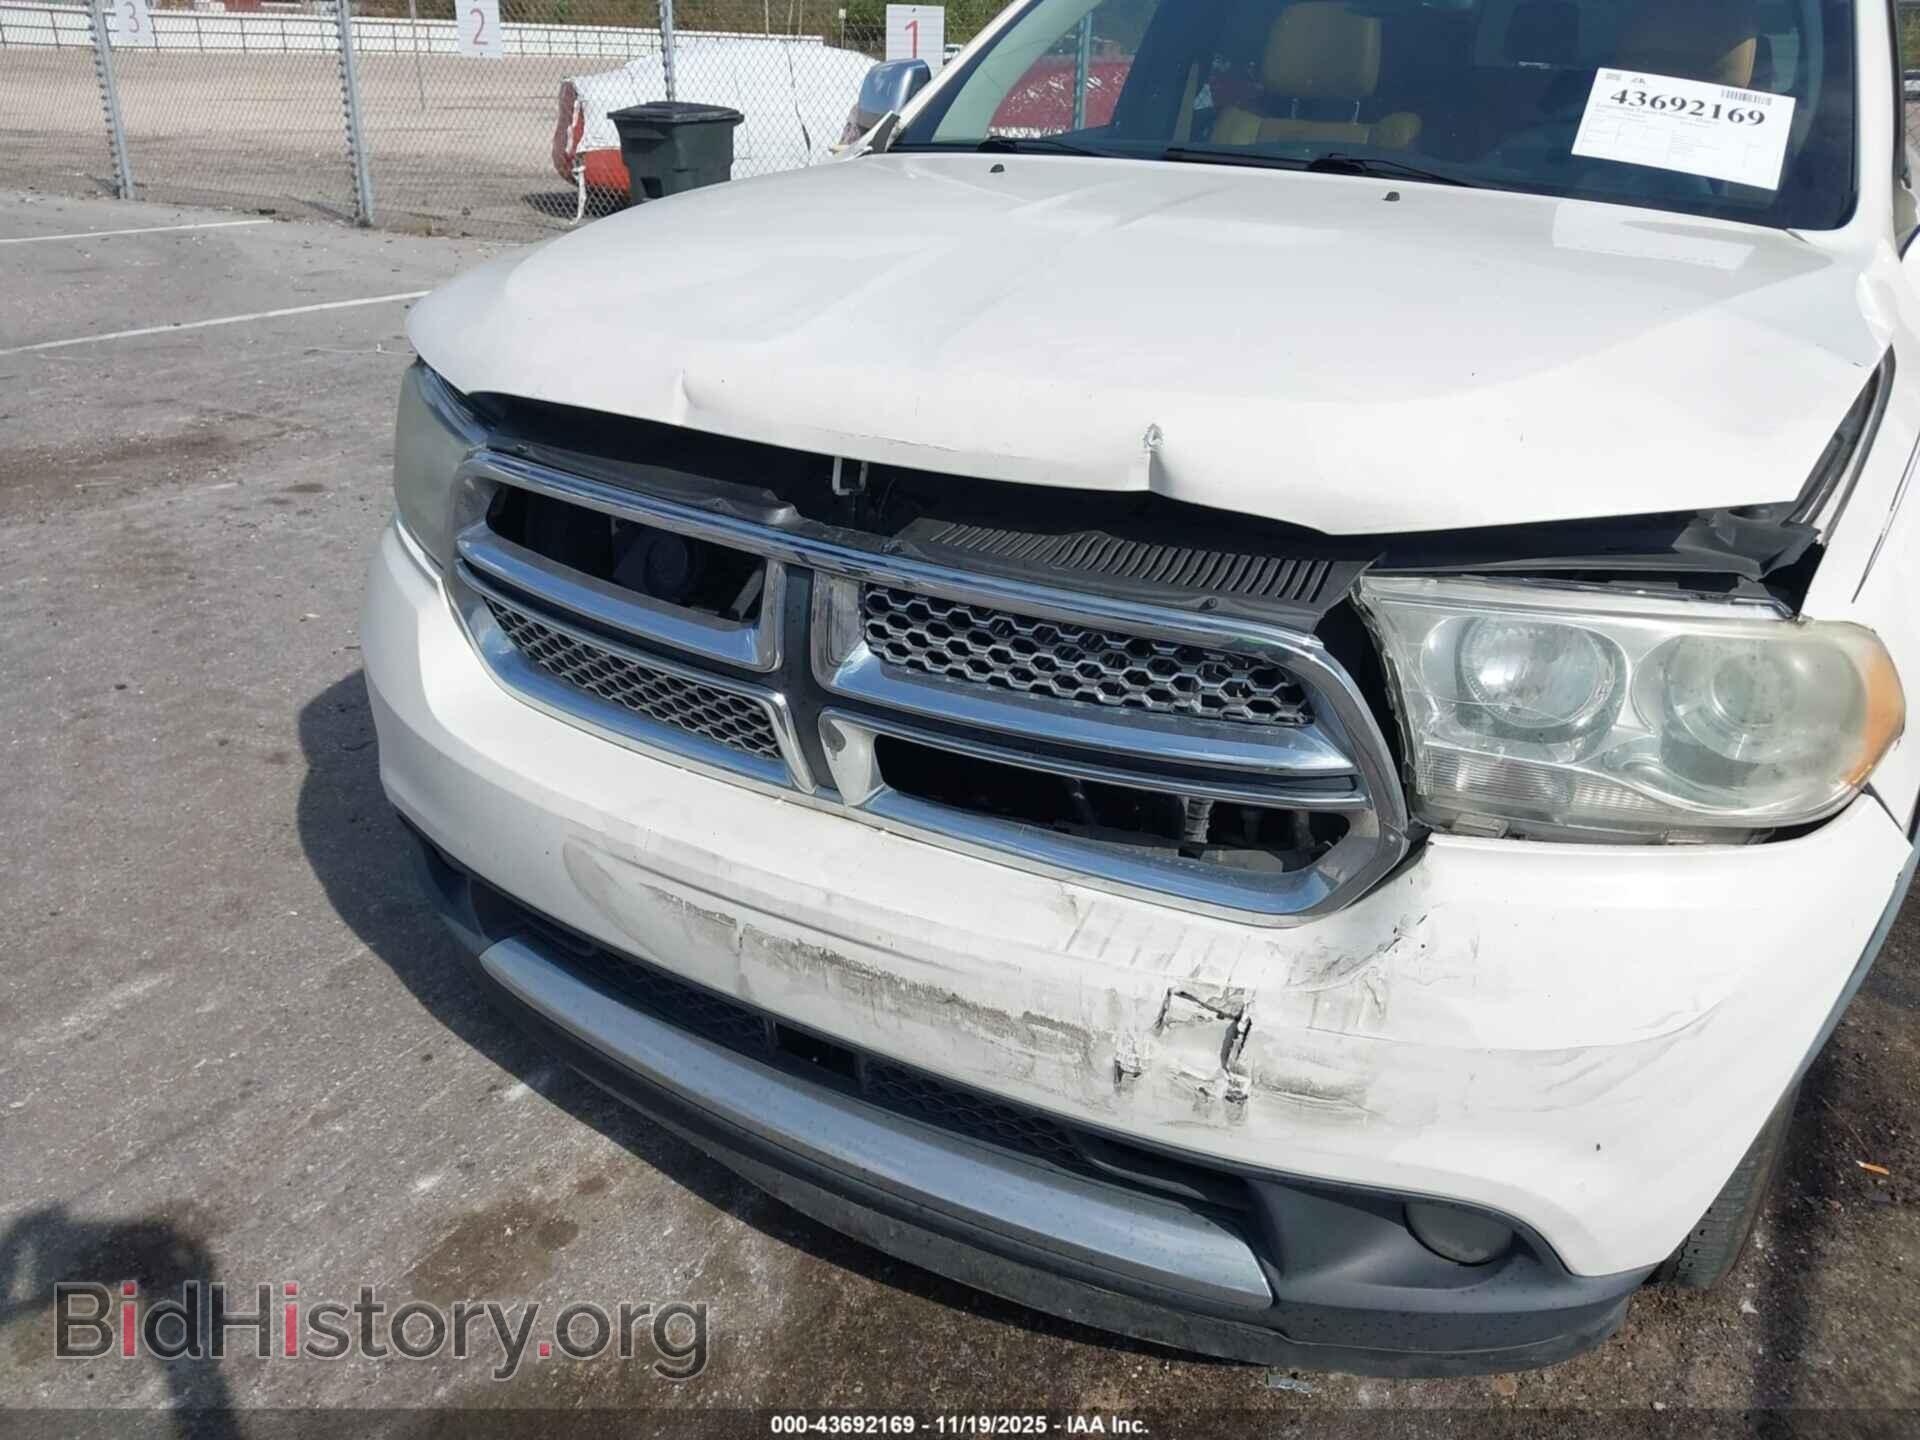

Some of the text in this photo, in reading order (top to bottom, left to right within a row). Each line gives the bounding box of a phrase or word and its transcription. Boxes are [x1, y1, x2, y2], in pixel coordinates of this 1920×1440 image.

[123, 1, 140, 33] 3
[470, 8, 488, 45] 2
[905, 19, 918, 59] 1
[1610, 88, 1766, 126] 43692169
